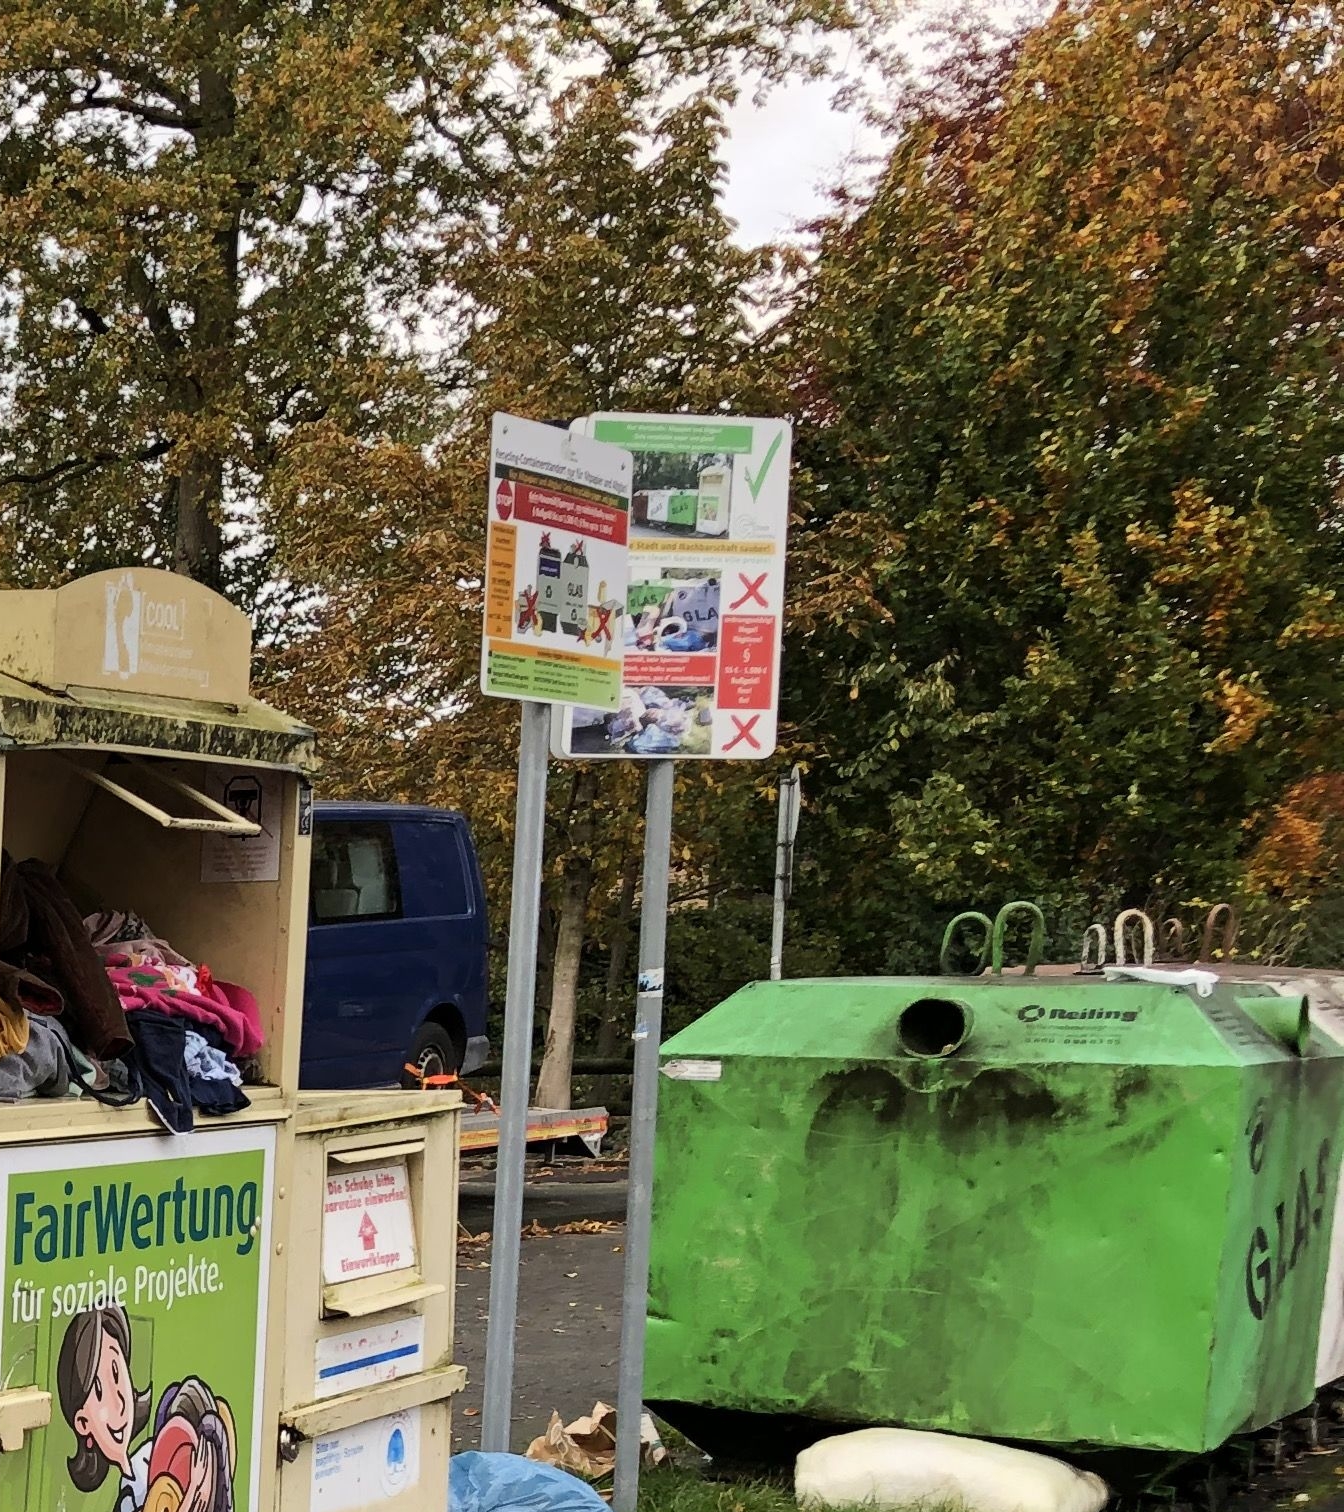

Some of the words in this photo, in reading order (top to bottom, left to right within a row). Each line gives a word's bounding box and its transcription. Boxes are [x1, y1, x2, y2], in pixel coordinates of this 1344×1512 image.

[1049, 1008, 1138, 1022] Reiling
[327, 1181, 342, 1195] Die
[345, 1176, 373, 1193] Schuhe
[376, 1173, 395, 1188] bitte
[13, 1176, 258, 1266] FairWertung
[12, 1277, 45, 1323] für
[51, 1265, 127, 1319] soziale
[134, 1253, 223, 1310] Projekte.
